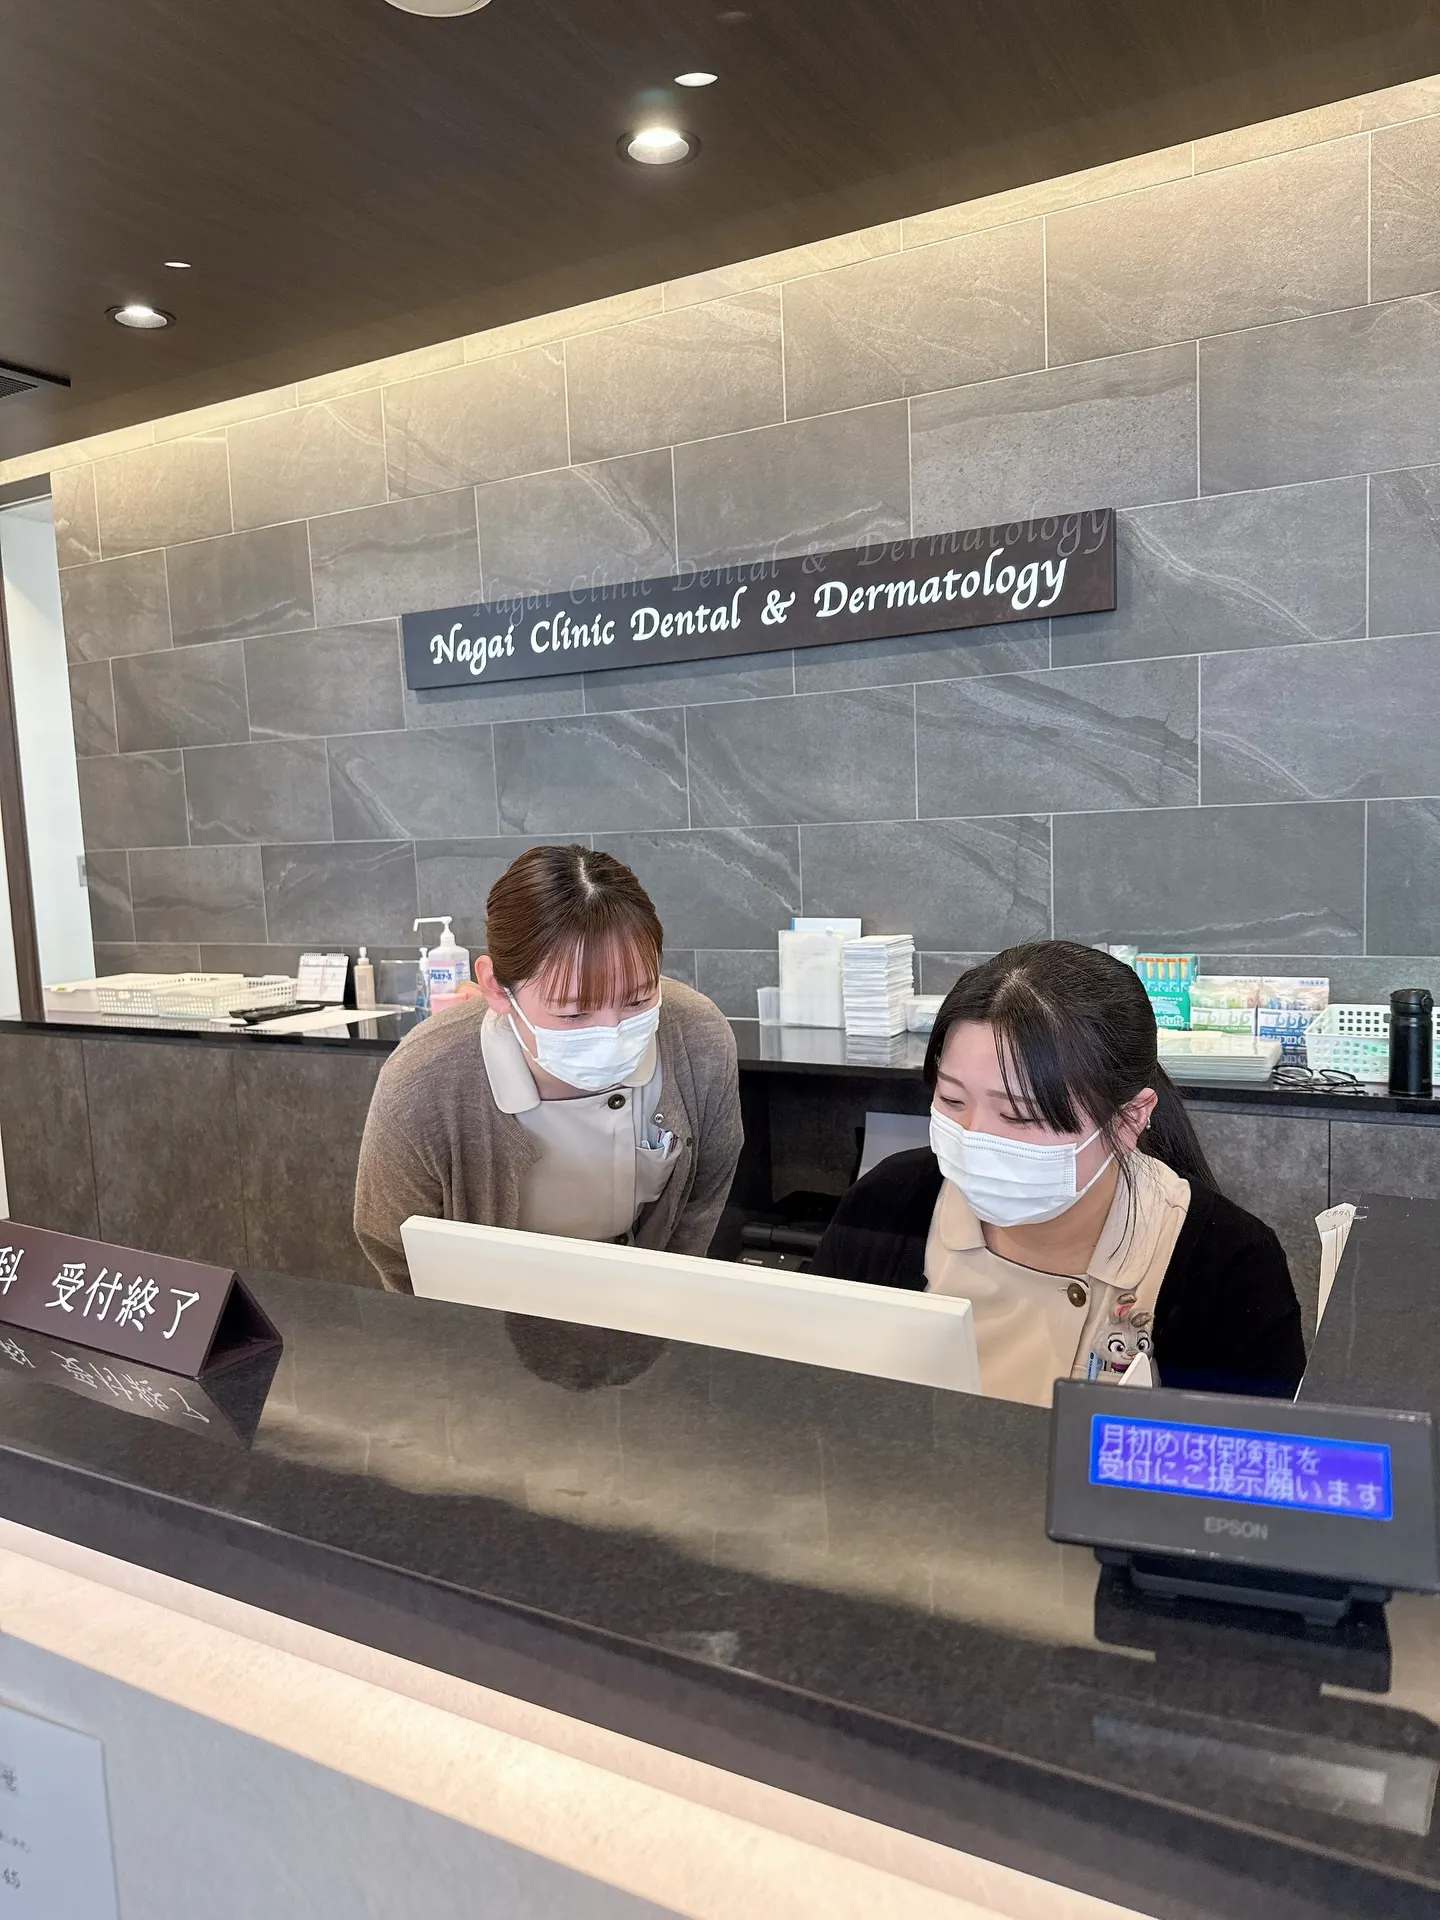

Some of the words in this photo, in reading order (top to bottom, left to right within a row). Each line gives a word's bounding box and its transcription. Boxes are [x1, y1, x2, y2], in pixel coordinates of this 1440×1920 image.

[429, 622, 516, 676] Nagai
[530, 610, 615, 654] Clinic
[630, 585, 748, 641] Dental
[761, 589, 796, 626] &
[813, 547, 1068, 618] Dermatology
[1158, 1016, 1183, 1026] etuft
[45, 1262, 200, 1340] 受付終了
[1100, 1423, 1320, 1475] 月初めは保険証を
[1098, 1450, 1382, 1511] 受付にご提示願います
[1203, 1515, 1269, 1541] EPSON
